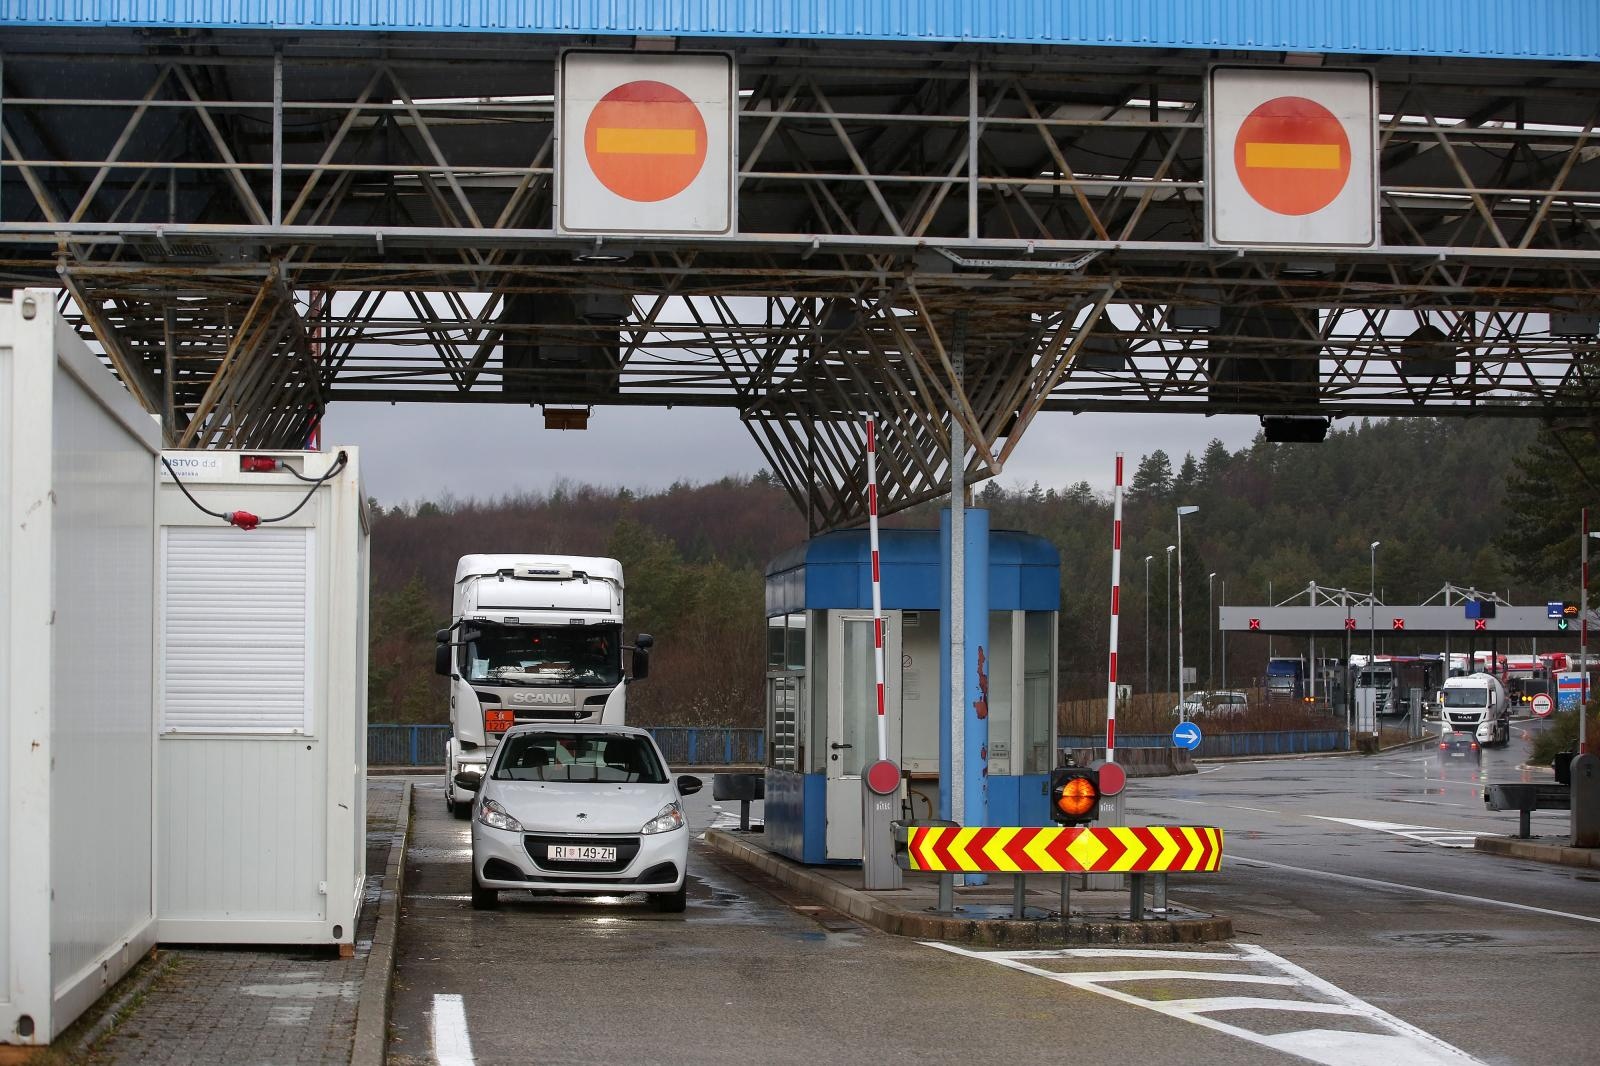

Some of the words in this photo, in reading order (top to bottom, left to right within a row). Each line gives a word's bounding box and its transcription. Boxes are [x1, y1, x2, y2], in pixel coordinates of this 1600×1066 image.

[513, 692, 572, 704] SCANIA
[555, 847, 567, 858] RI
[578, 847, 615, 859] 149-ZH
